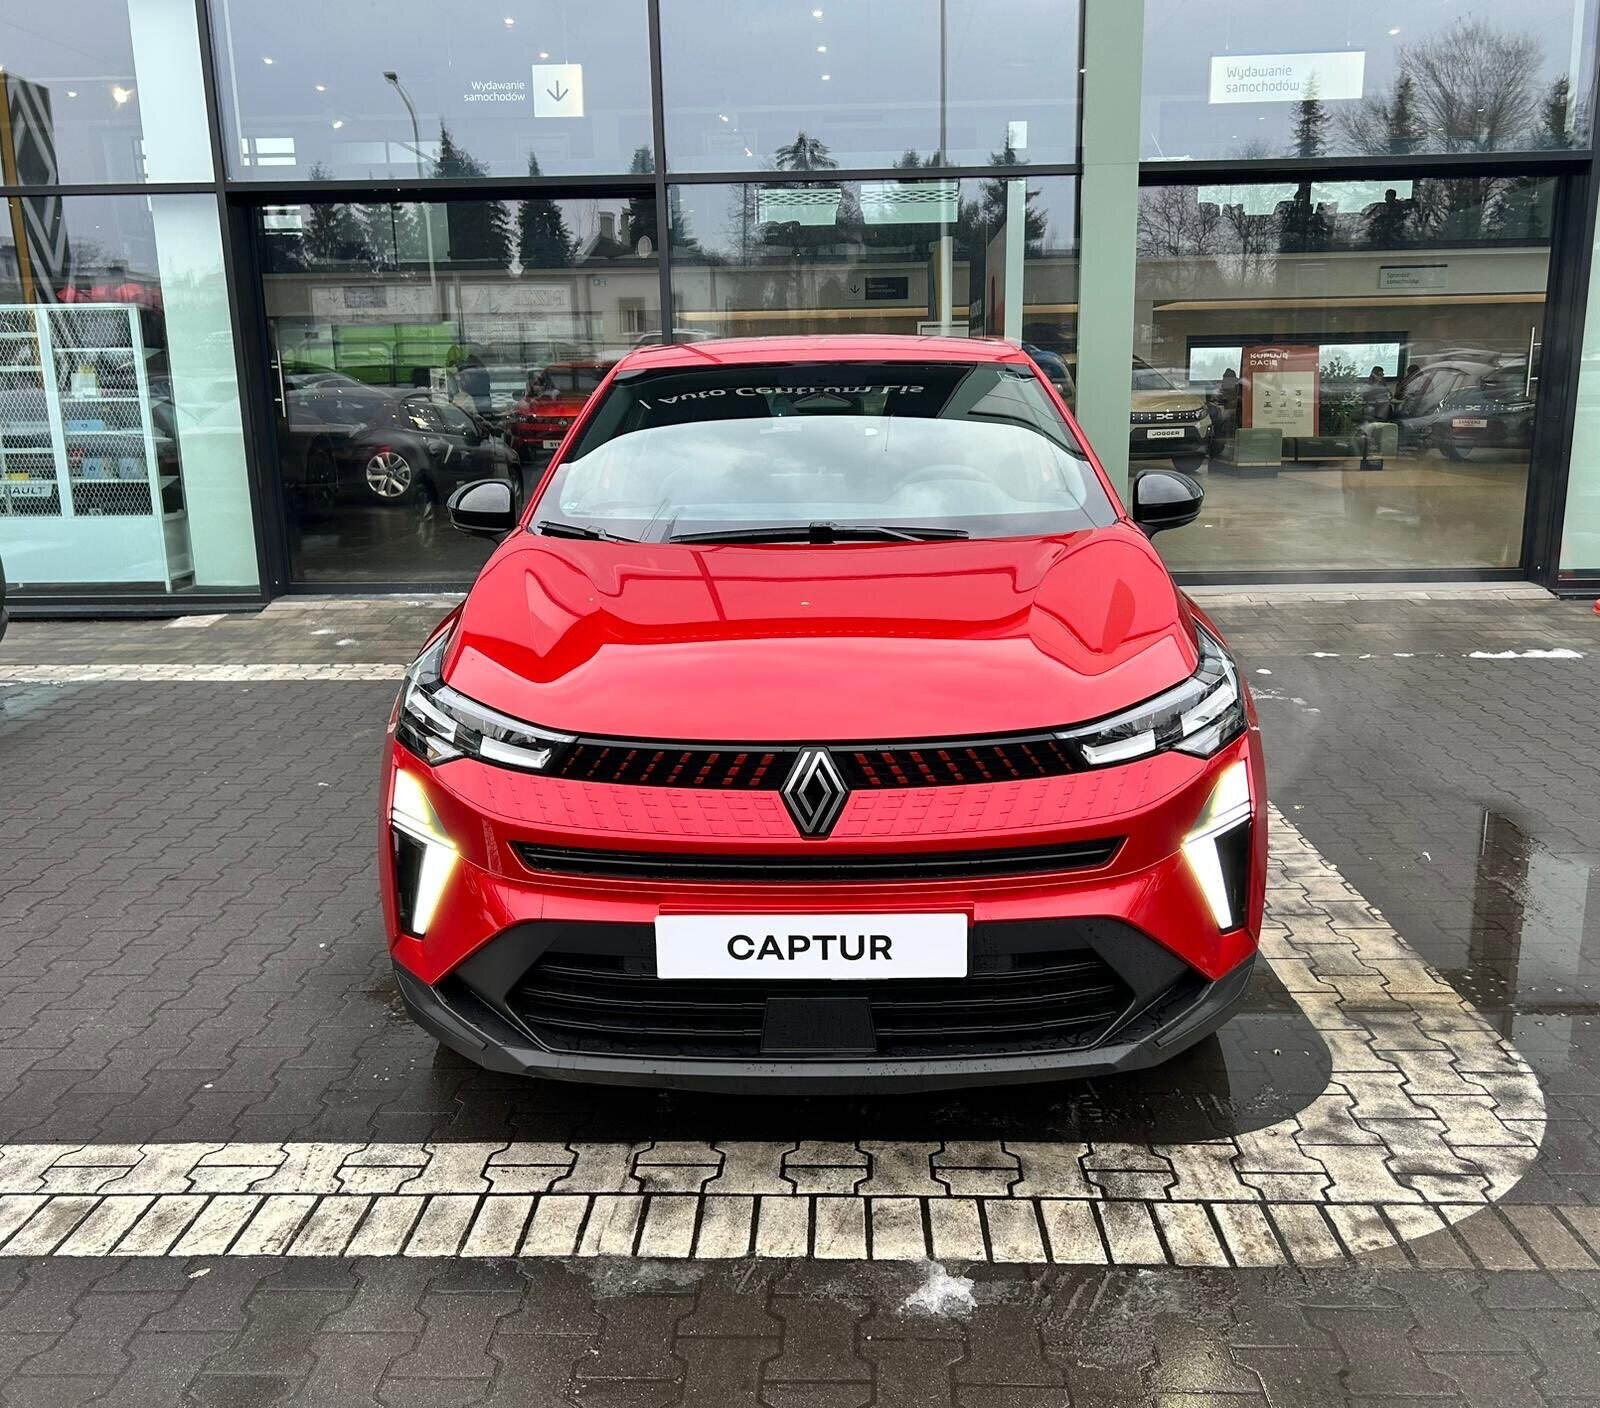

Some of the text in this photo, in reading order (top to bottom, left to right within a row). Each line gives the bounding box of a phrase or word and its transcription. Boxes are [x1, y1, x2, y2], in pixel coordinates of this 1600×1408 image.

[1226, 65, 1292, 80] Wydawanie
[471, 80, 525, 91] Wydawanie
[1226, 80, 1300, 93] samochodów
[463, 92, 526, 102] samochodów
[726, 934, 893, 961] CAPTUR
